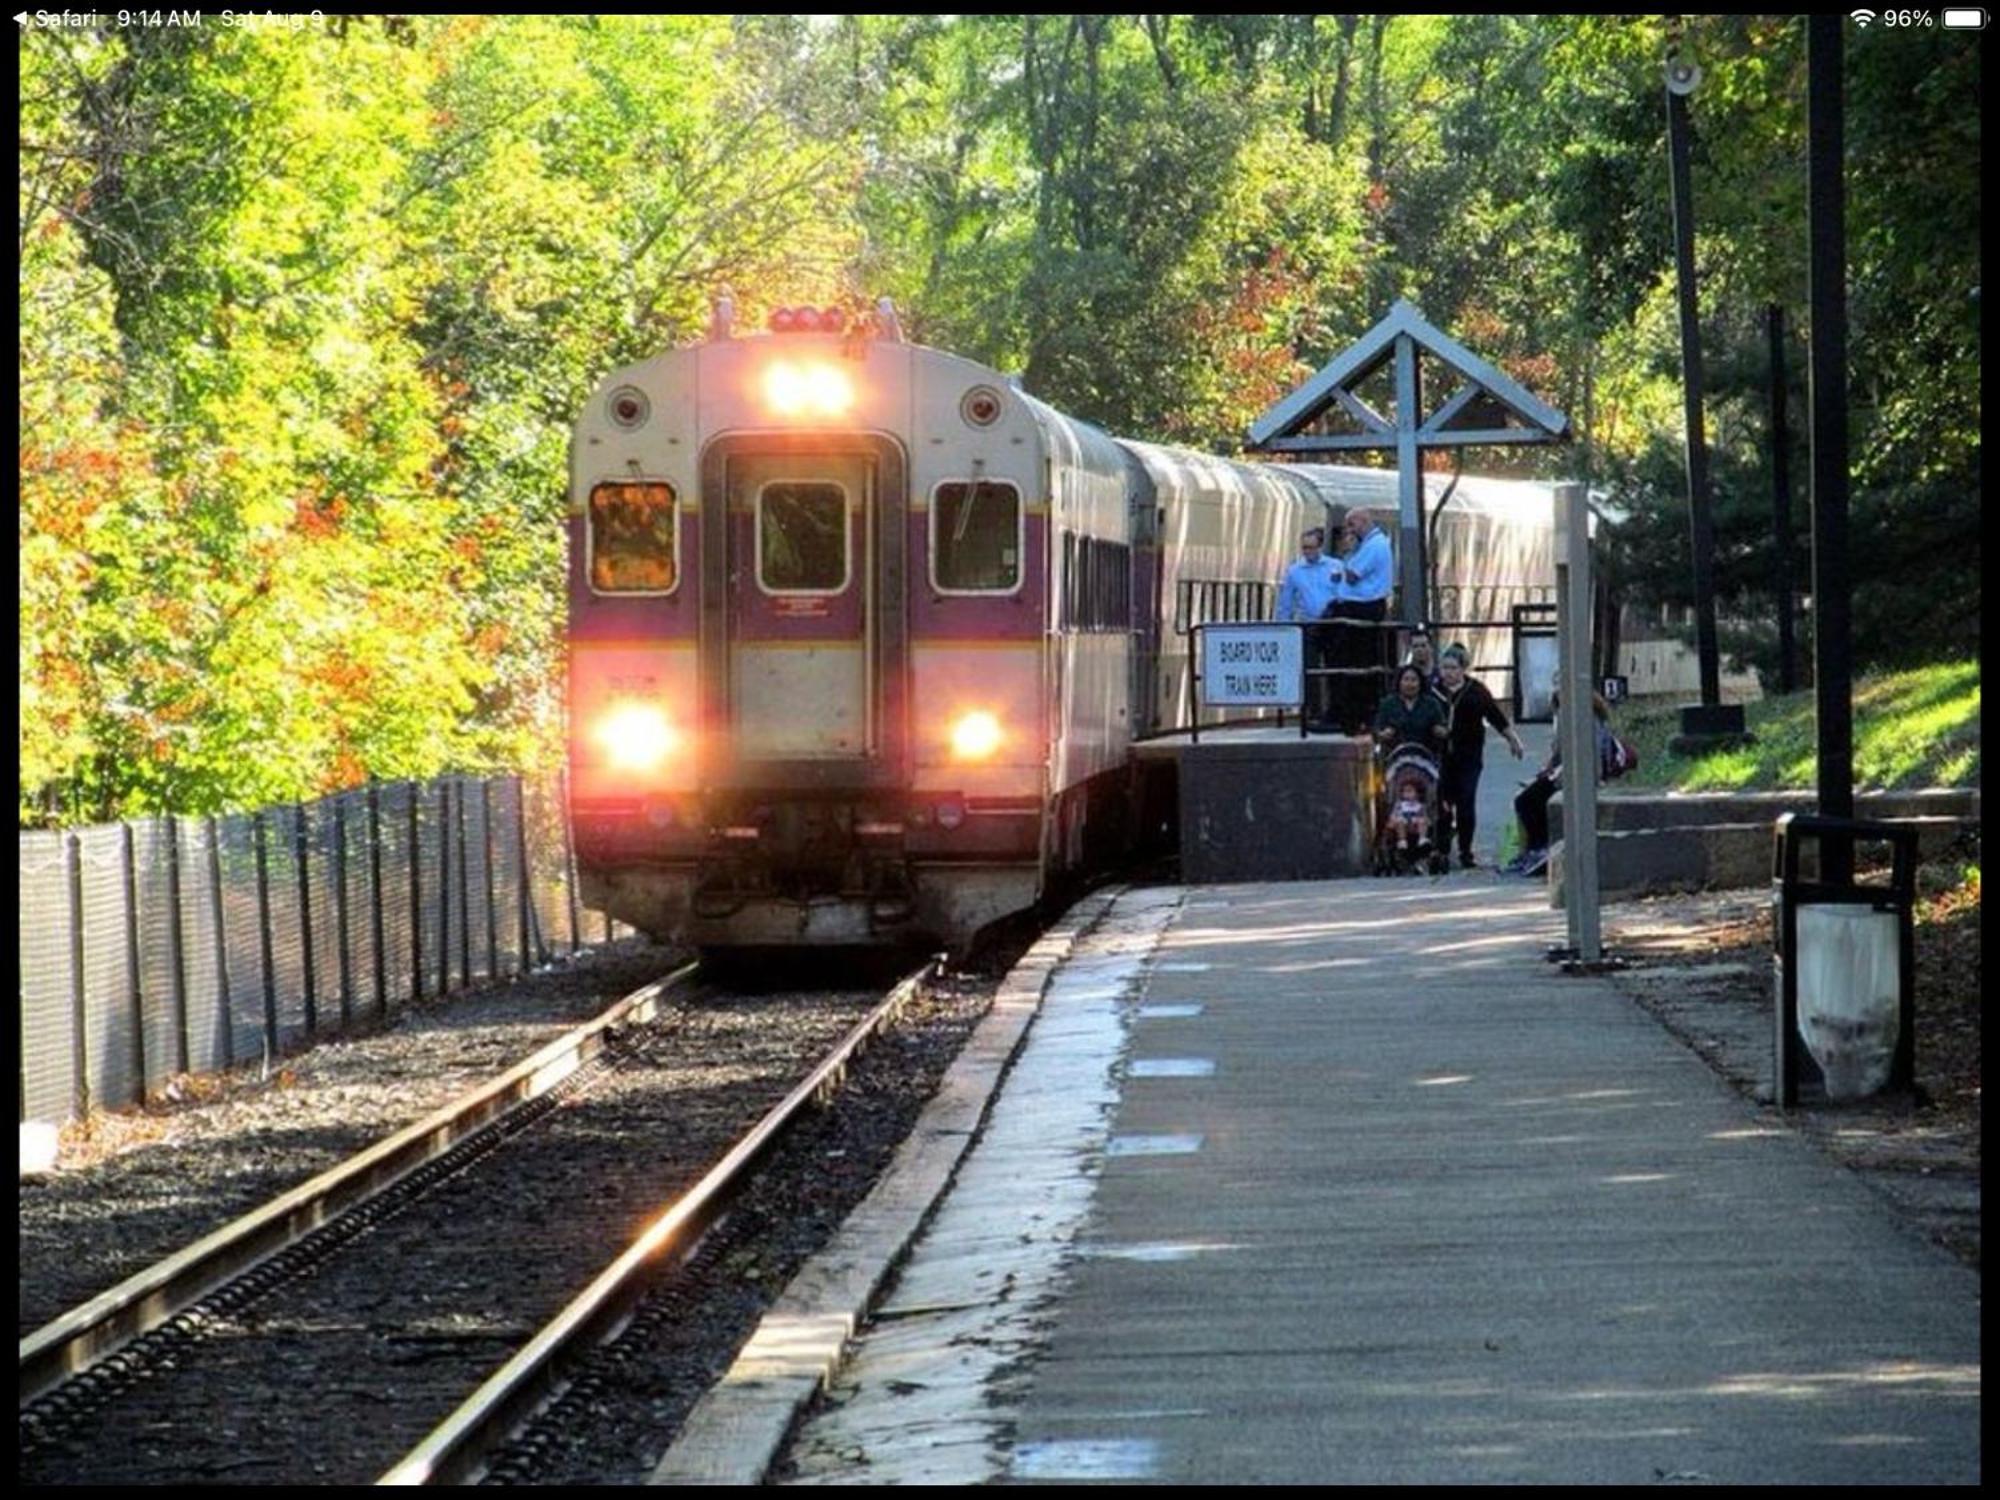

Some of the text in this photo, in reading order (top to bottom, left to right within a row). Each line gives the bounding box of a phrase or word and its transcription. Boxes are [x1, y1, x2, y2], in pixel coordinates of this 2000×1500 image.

[1220, 641, 1280, 663] BOARD YOUR
[1225, 675, 1278, 696] TRAIN HERE
